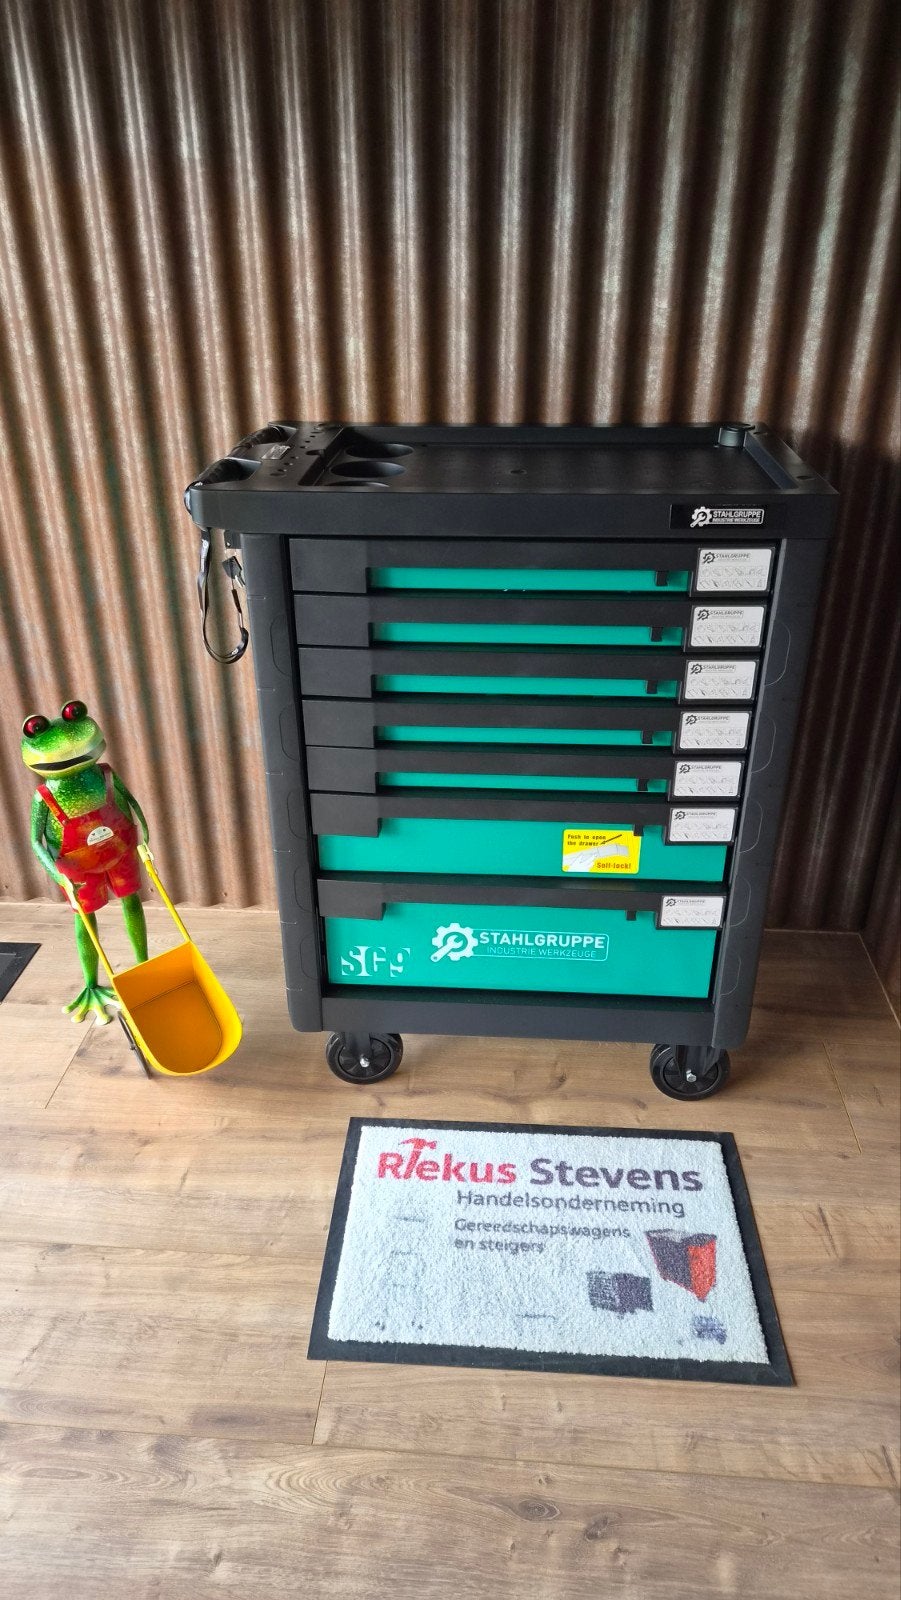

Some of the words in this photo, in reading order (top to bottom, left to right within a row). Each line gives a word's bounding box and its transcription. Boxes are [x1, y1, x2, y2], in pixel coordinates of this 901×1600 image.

[713, 510, 761, 518] STAHLGRUPPE
[479, 931, 606, 949] STAHLGRUPPE
[487, 946, 536, 956] INDUSTRIE
[538, 948, 597, 958] WERKZEUGE
[529, 1157, 704, 1193] Stevens
[456, 1189, 686, 1219] Handelsonderneming
[454, 1217, 632, 1240] Gereedschapswagens
[454, 1238, 475, 1250] en
[479, 1238, 546, 1256] steigers
